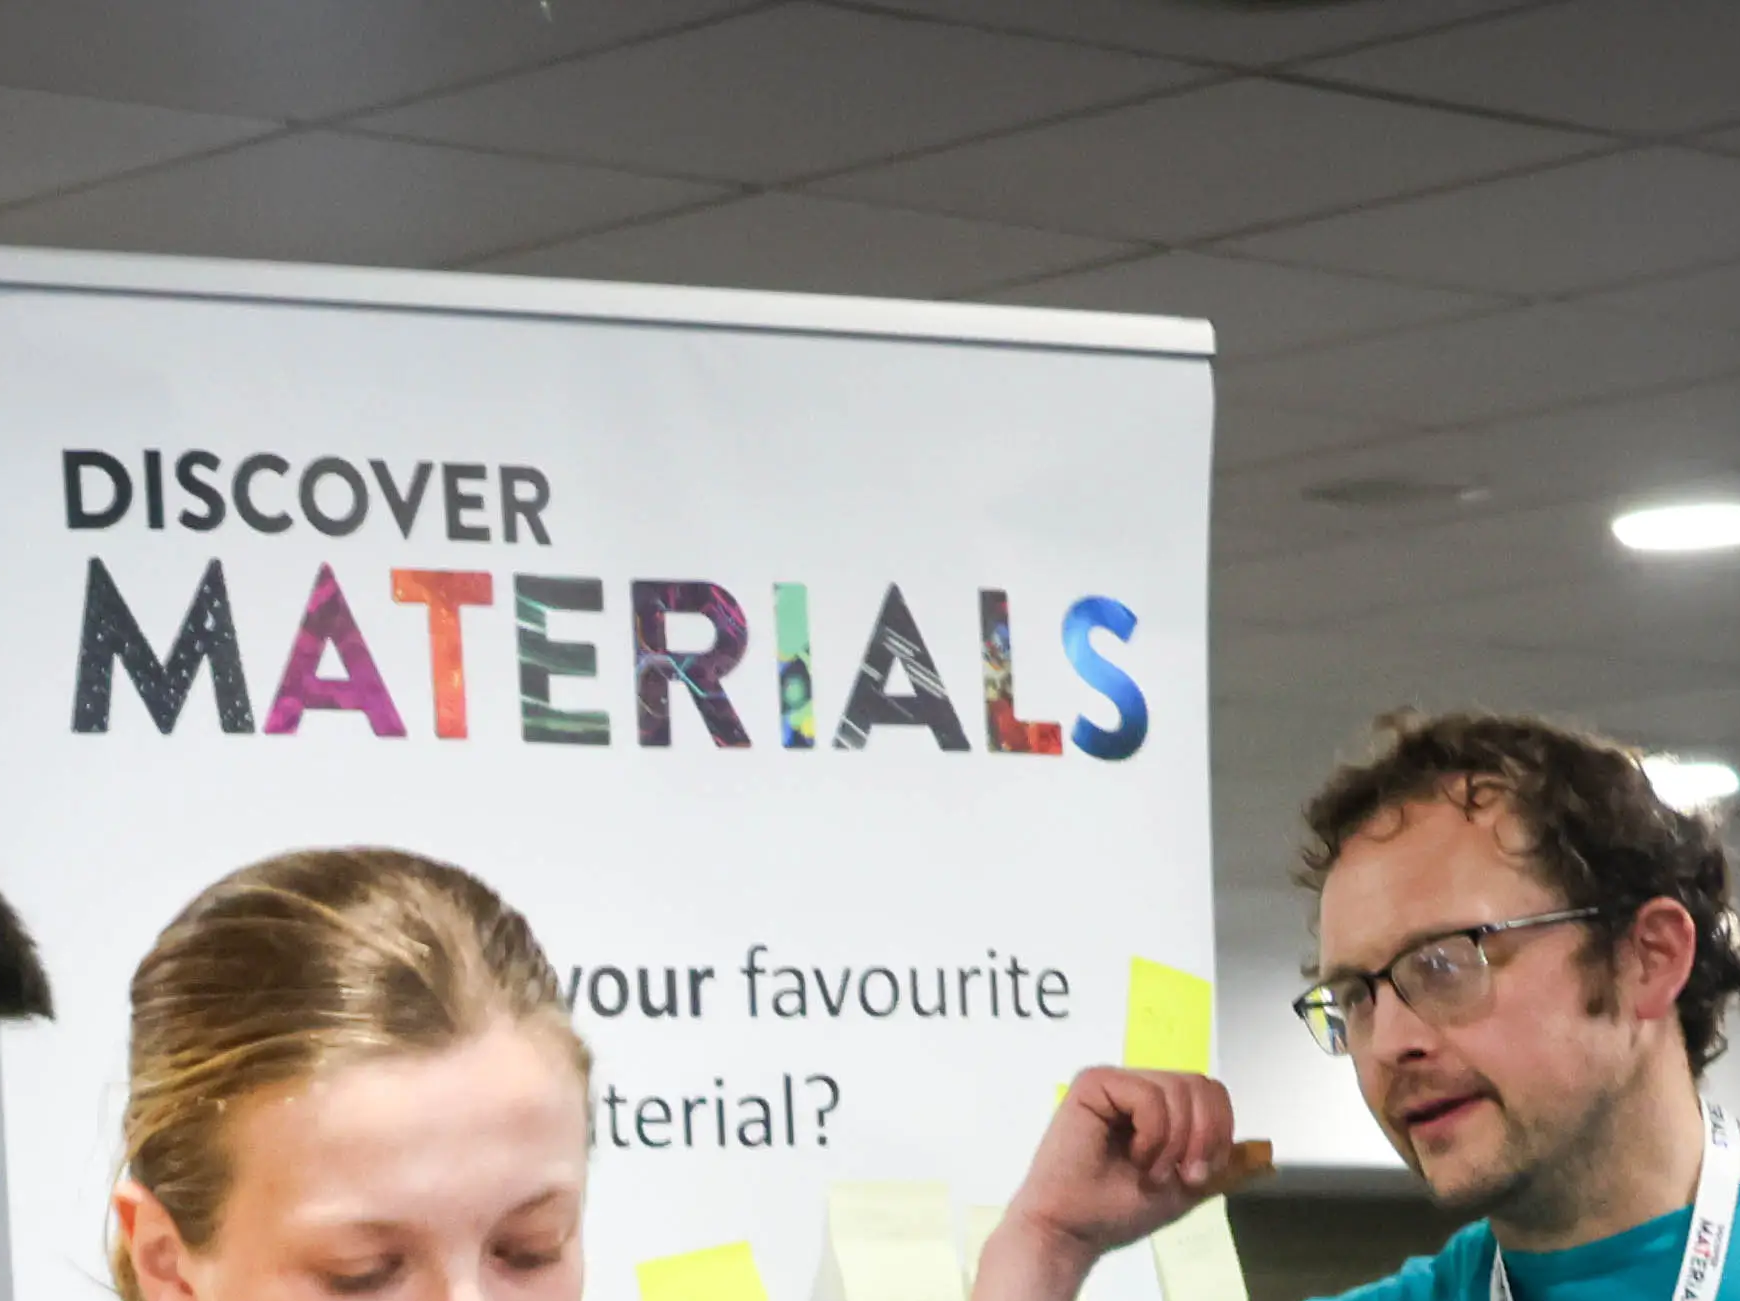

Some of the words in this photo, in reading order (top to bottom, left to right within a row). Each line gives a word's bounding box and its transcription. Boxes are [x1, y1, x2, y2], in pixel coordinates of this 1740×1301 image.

[61, 449, 552, 545] DISCOVER
[71, 557, 1151, 762] MATERIALS
[741, 945, 1072, 1018] favourite
[586, 1074, 841, 1148] terial?
